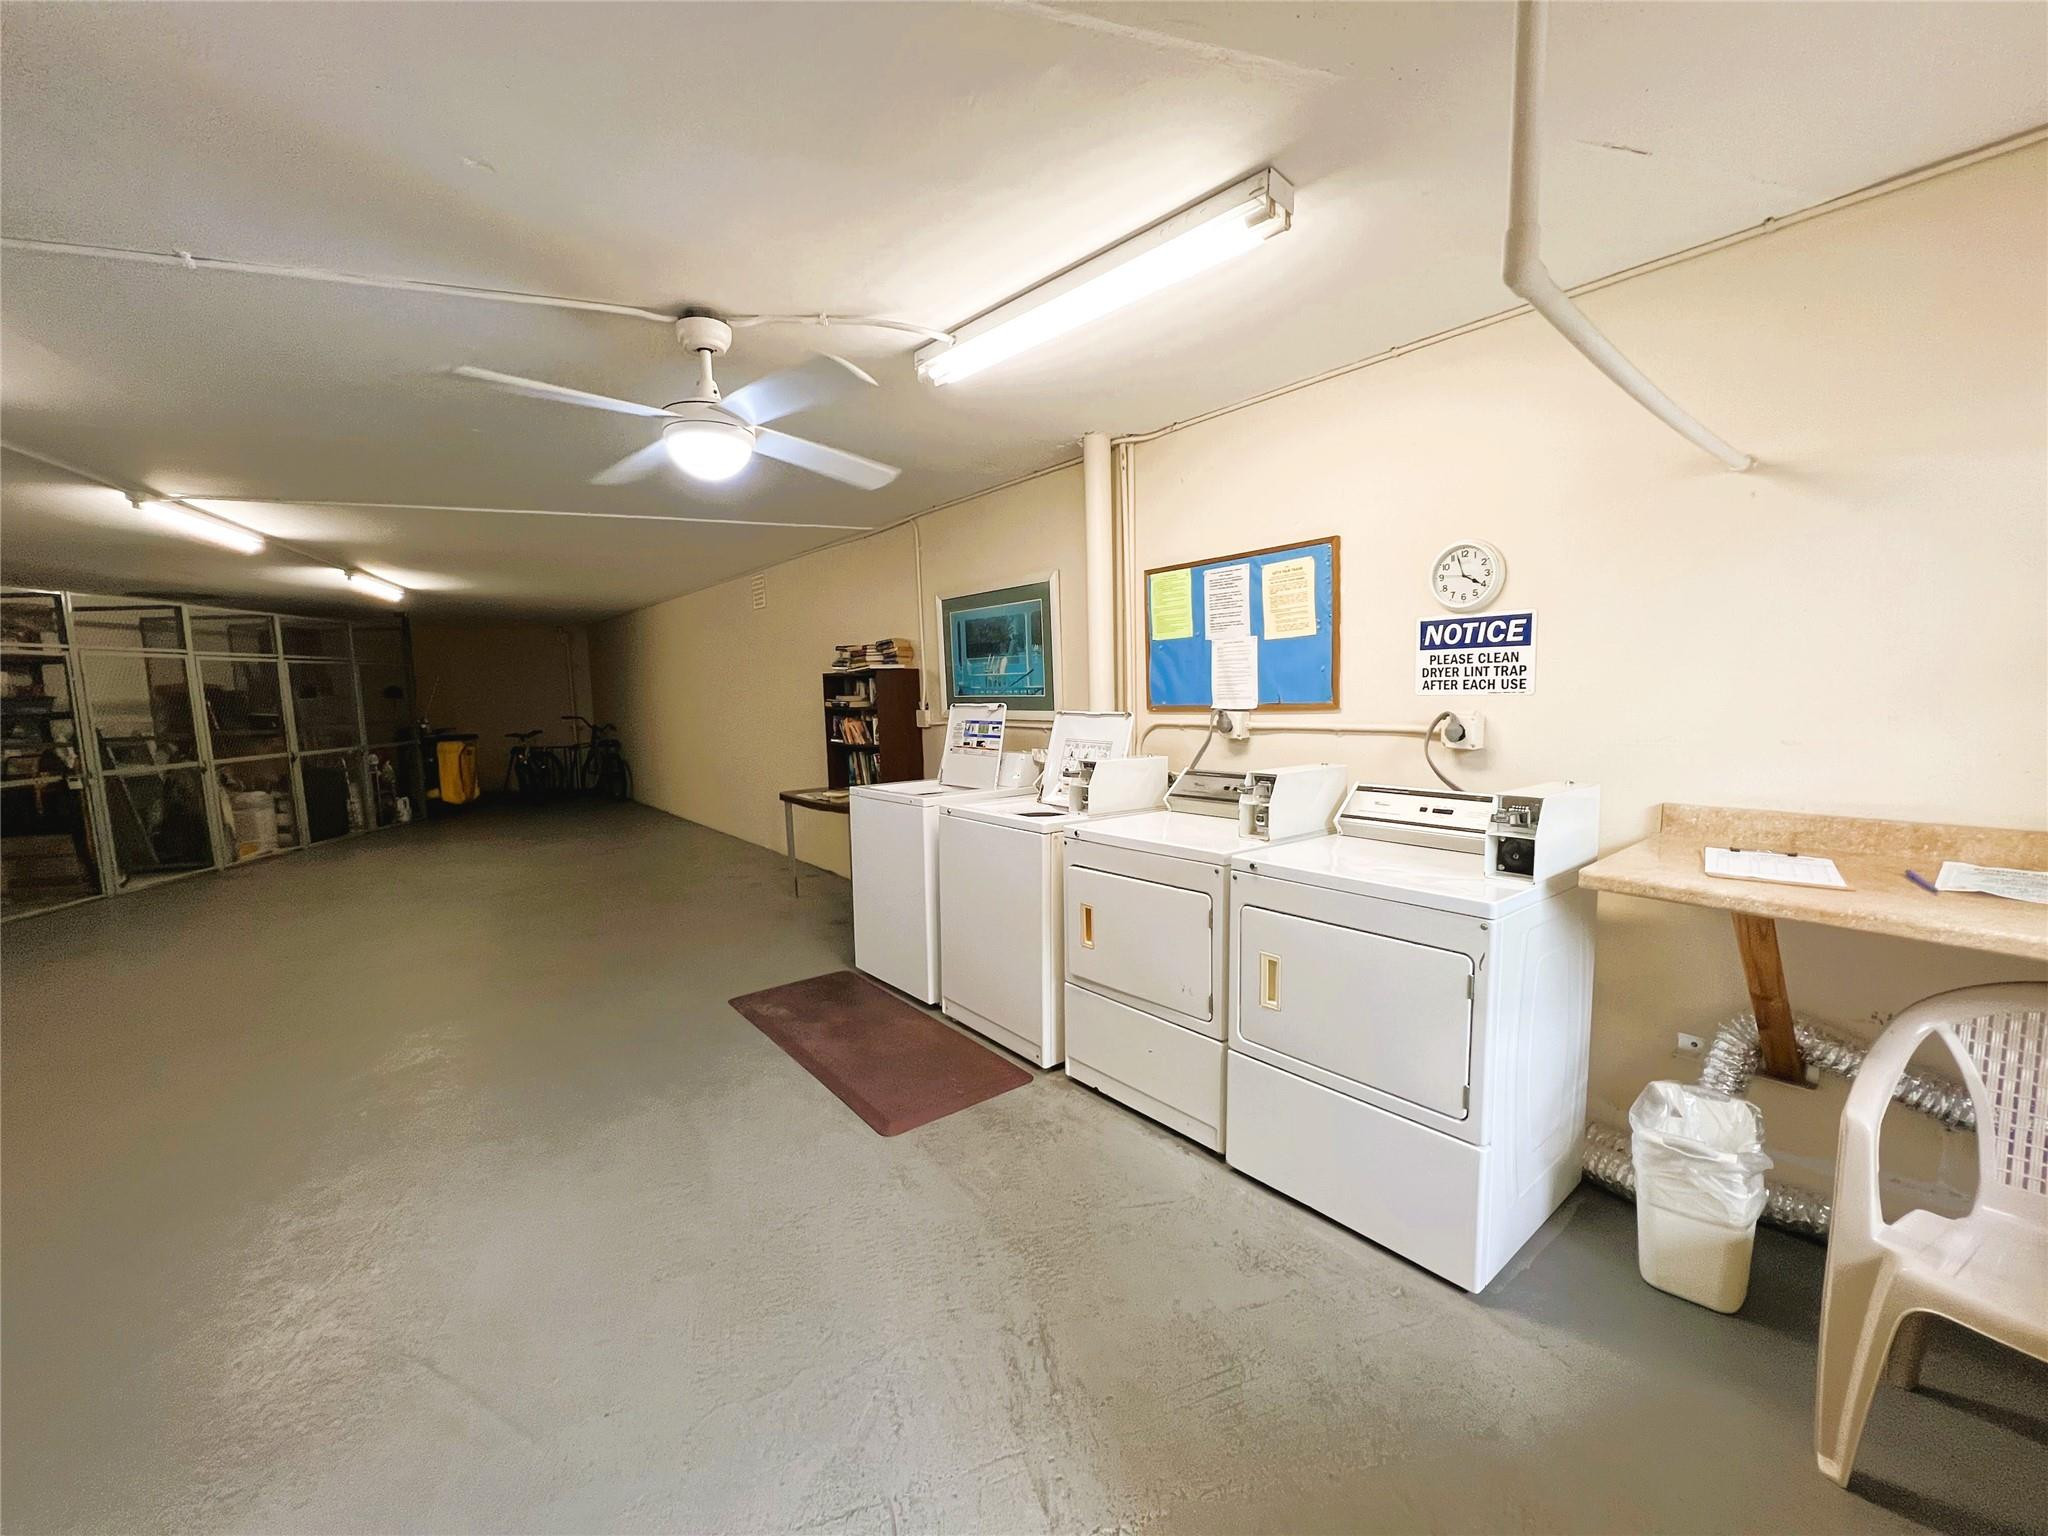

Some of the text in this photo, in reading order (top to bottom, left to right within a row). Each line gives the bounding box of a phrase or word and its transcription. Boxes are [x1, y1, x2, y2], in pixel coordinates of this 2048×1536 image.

[1461, 549, 1469, 558] 12
[1481, 558, 1487, 566] 2
[1442, 563, 1450, 571] 10
[1484, 569, 1491, 577] 3
[1438, 574, 1445, 582] 9
[1442, 584, 1448, 592] 8
[1450, 591, 1456, 599] 7
[1460, 593, 1467, 601] 6
[1472, 589, 1479, 597] 5
[1424, 618, 1527, 646] NOTICE
[1429, 651, 1519, 665] PLEASE CLEAN
[1422, 664, 1527, 678] DRYER LINT TRAP
[1422, 678, 1527, 690] AFTER EACH USE
